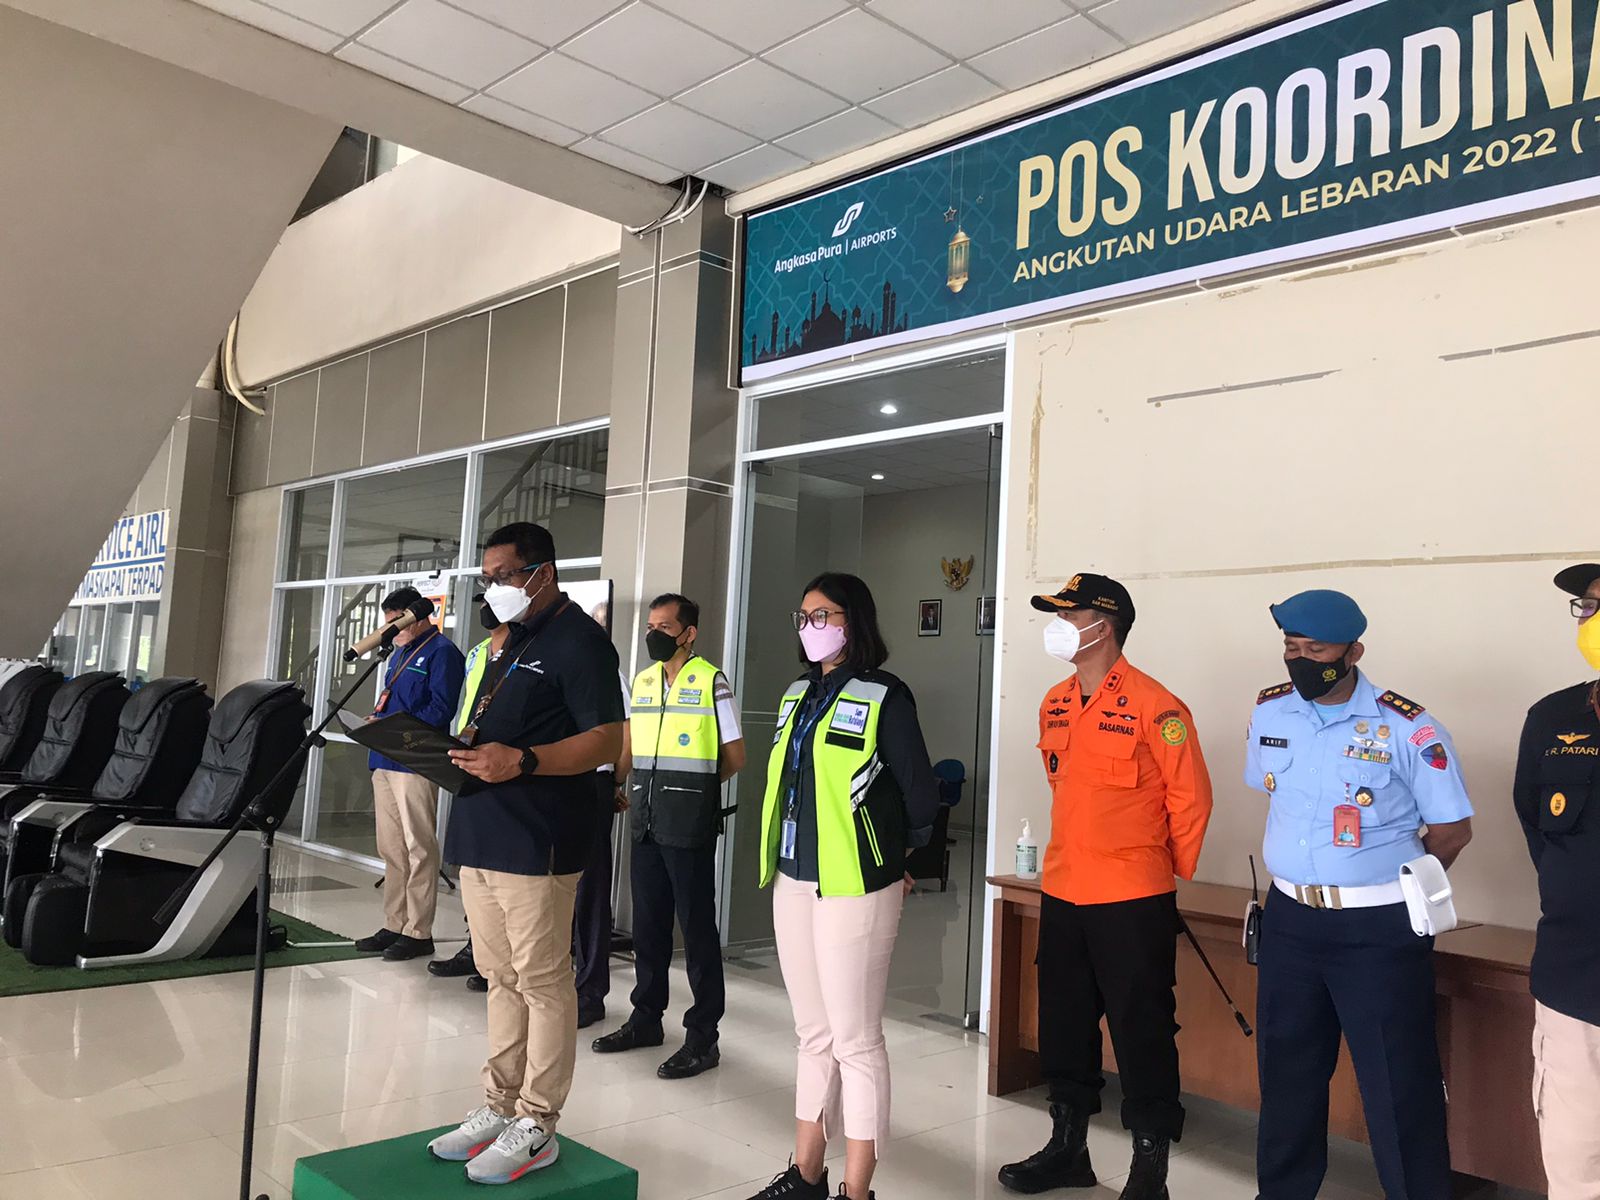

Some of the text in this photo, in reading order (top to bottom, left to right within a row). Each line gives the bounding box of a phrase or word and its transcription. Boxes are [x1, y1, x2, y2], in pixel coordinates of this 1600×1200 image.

[1016, 0, 1600, 250] POS KOORDIN
[851, 227, 897, 251] AIRPORTS
[1012, 227, 1156, 282] ANGKUTAN
[1165, 199, 1272, 246] UDARA
[1281, 153, 1450, 218] LEBARAN
[1462, 127, 1557, 174] 2022
[1098, 722, 1135, 736] BASARNAS
